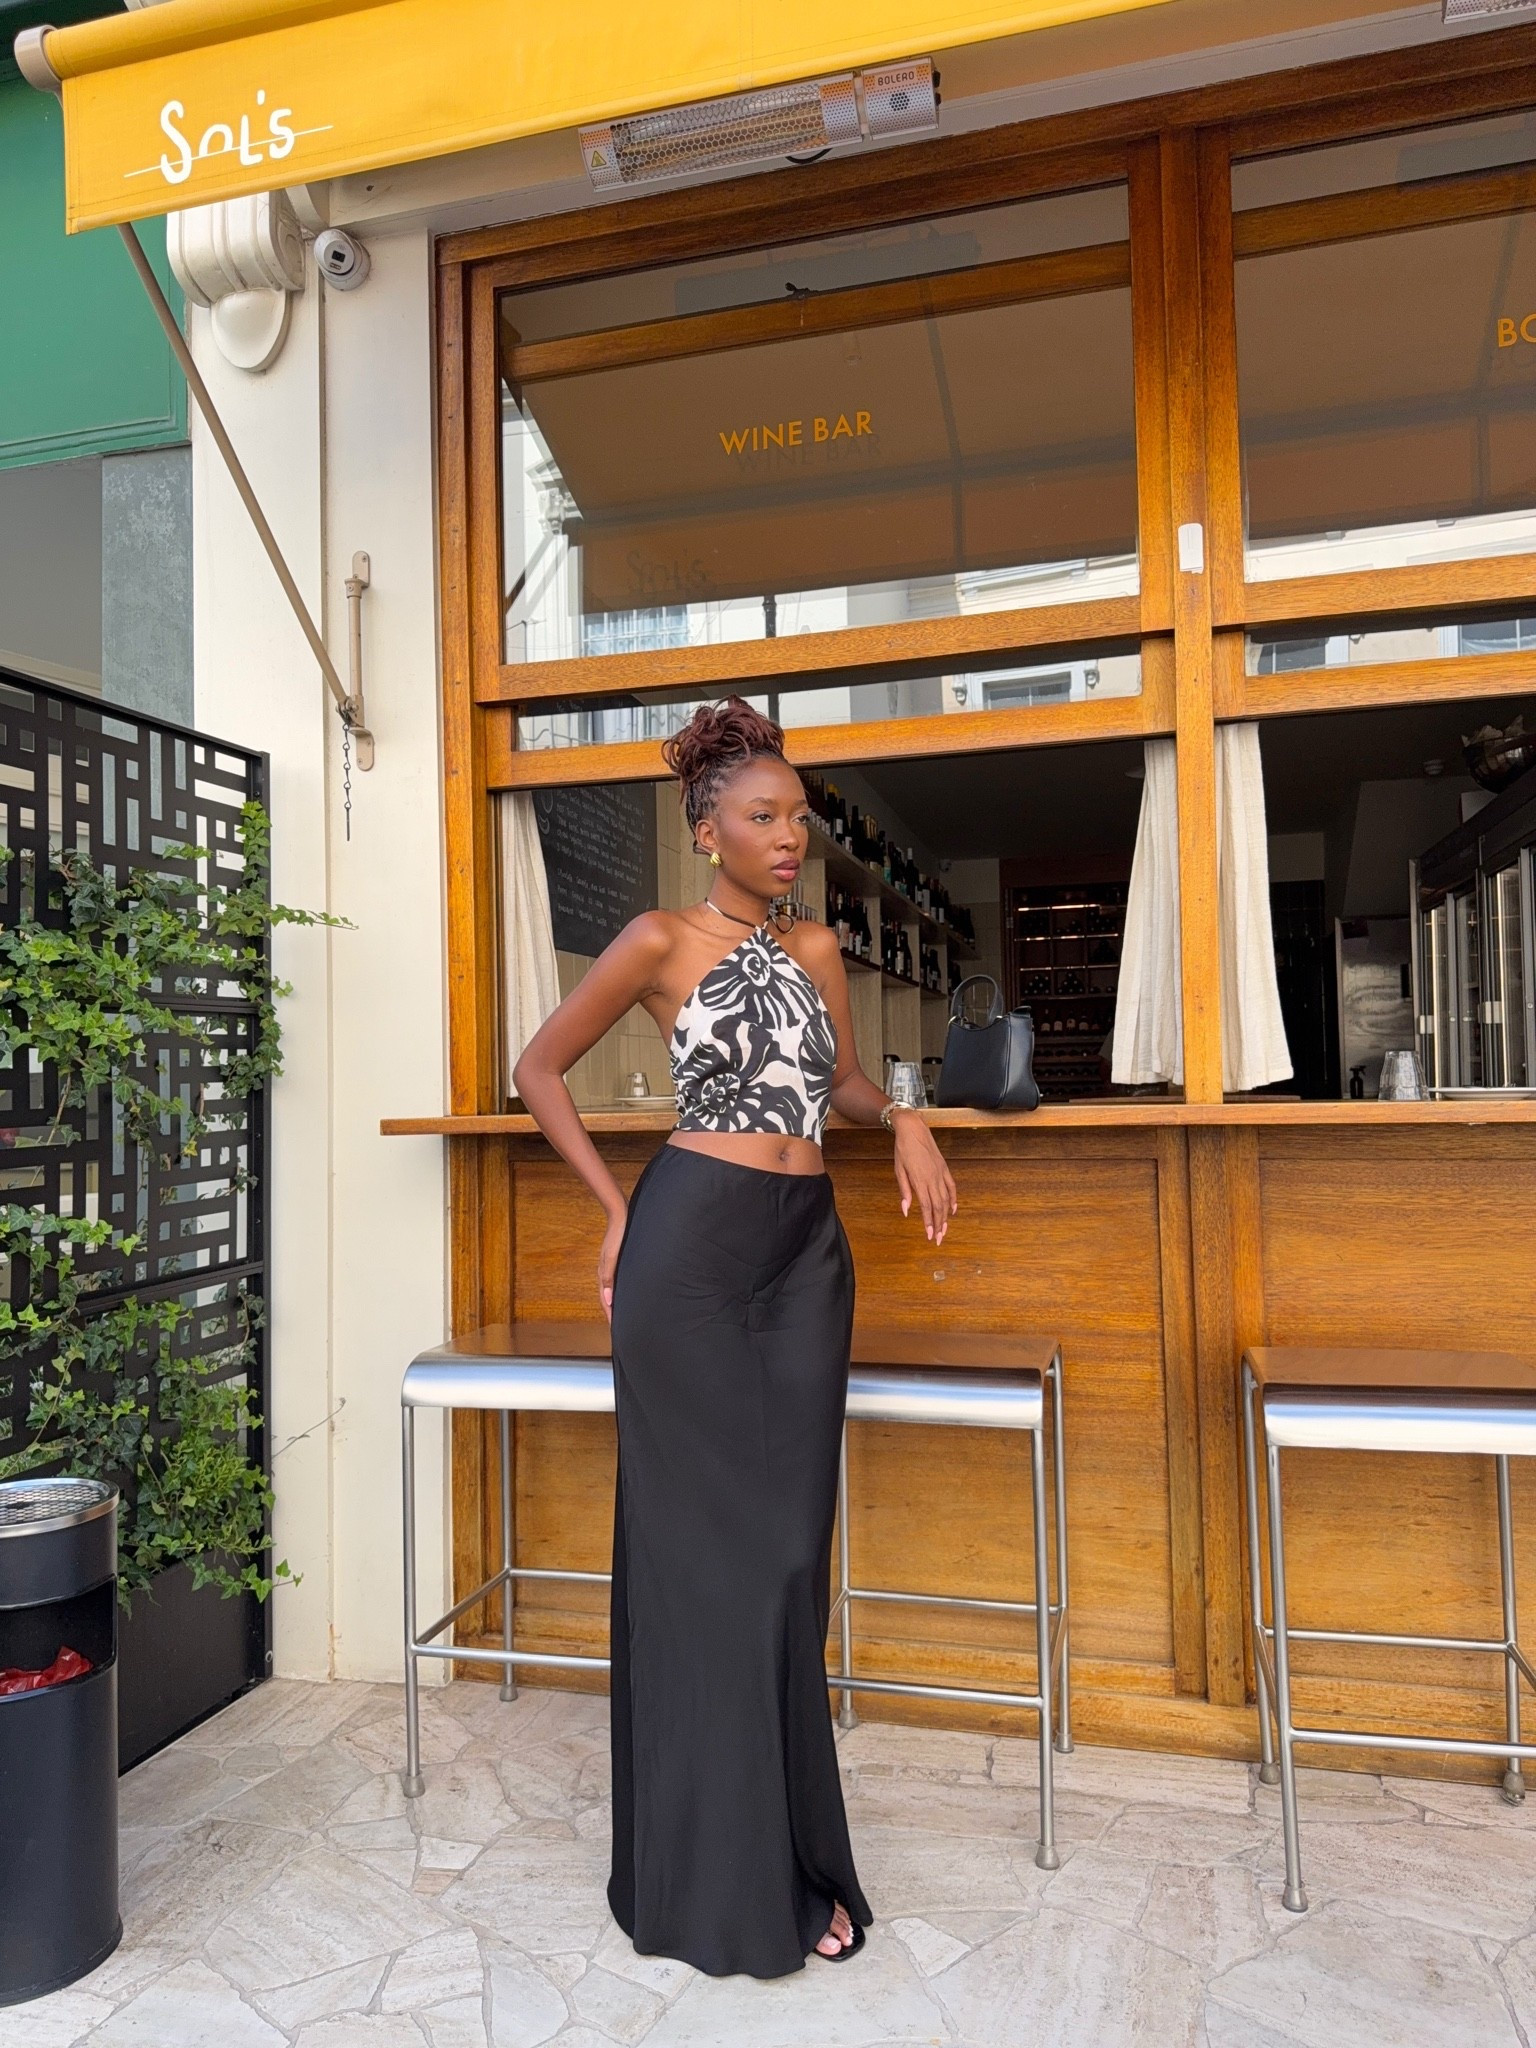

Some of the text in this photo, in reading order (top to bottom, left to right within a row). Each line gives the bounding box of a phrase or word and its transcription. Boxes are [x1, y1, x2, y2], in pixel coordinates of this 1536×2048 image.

[877, 71, 915, 86] BOLERO
[719, 411, 873, 456] WINE BAR
